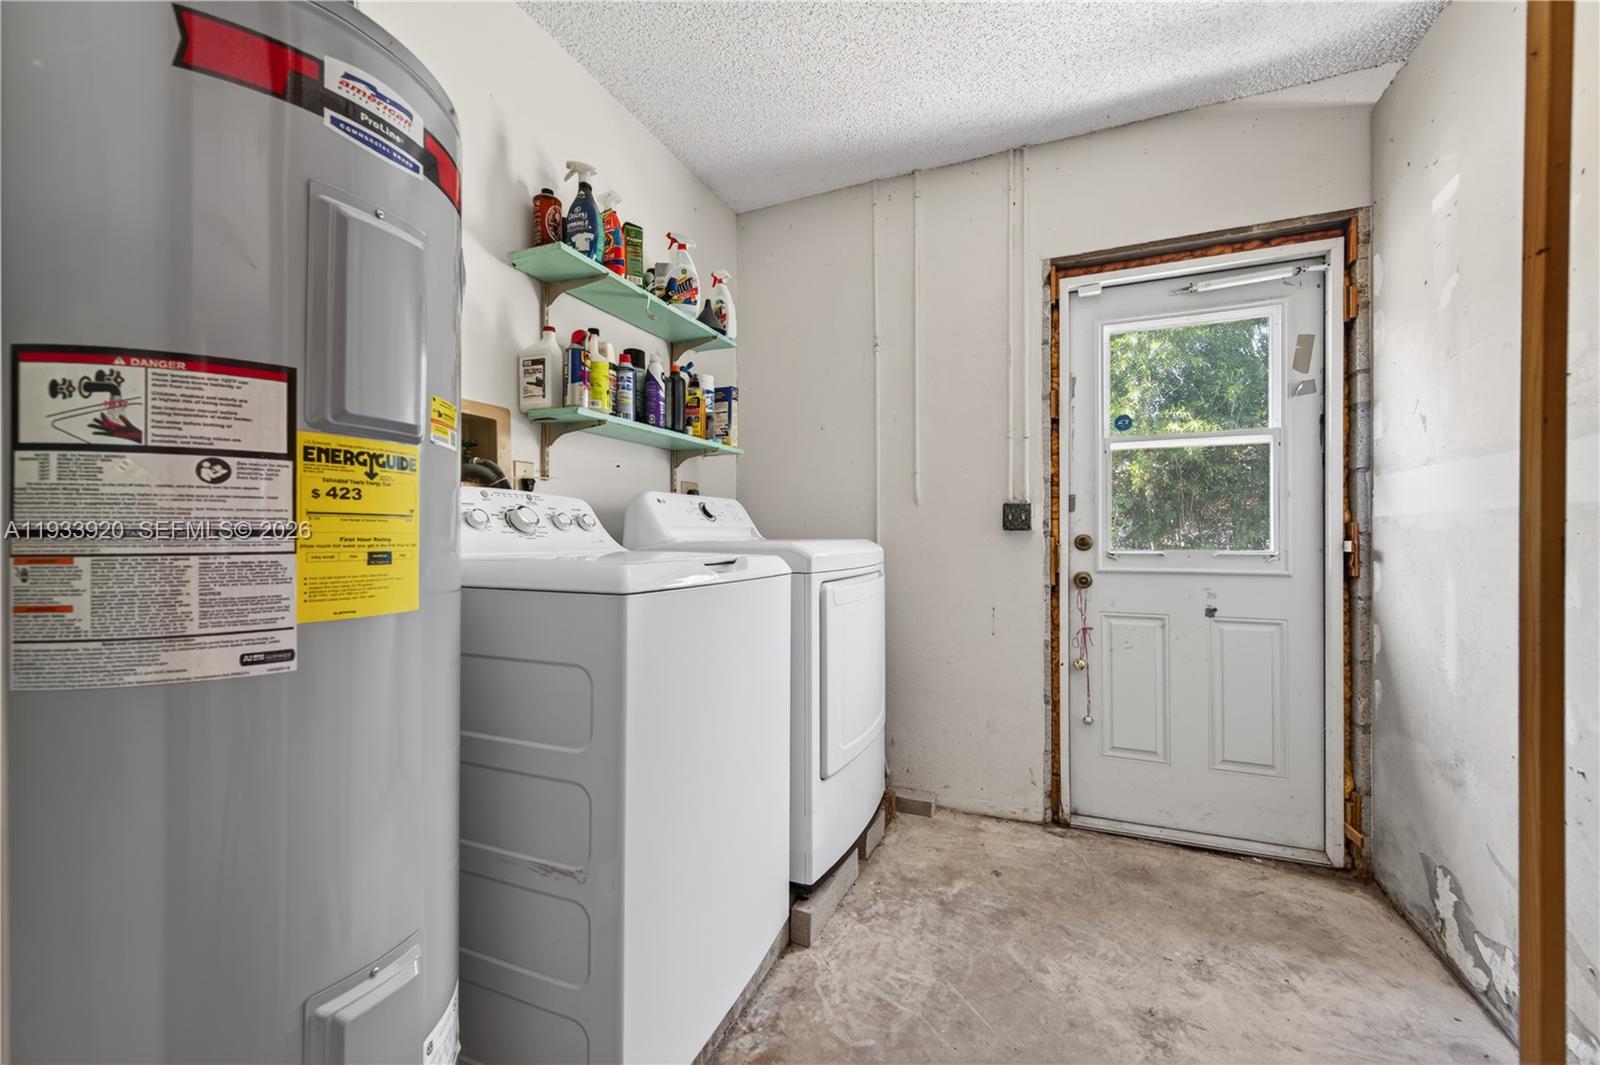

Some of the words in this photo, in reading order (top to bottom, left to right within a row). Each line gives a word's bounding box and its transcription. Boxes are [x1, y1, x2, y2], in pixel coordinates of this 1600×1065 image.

[339, 80, 414, 128] american
[360, 112, 404, 144] ProLine
[340, 123, 390, 152] COMMERCIAL
[393, 152, 414, 168] BRAND
[130, 358, 186, 370] DANGER
[303, 445, 417, 472] ENERGYGUIDE
[311, 488, 321, 500] $
[326, 486, 362, 500] 423
